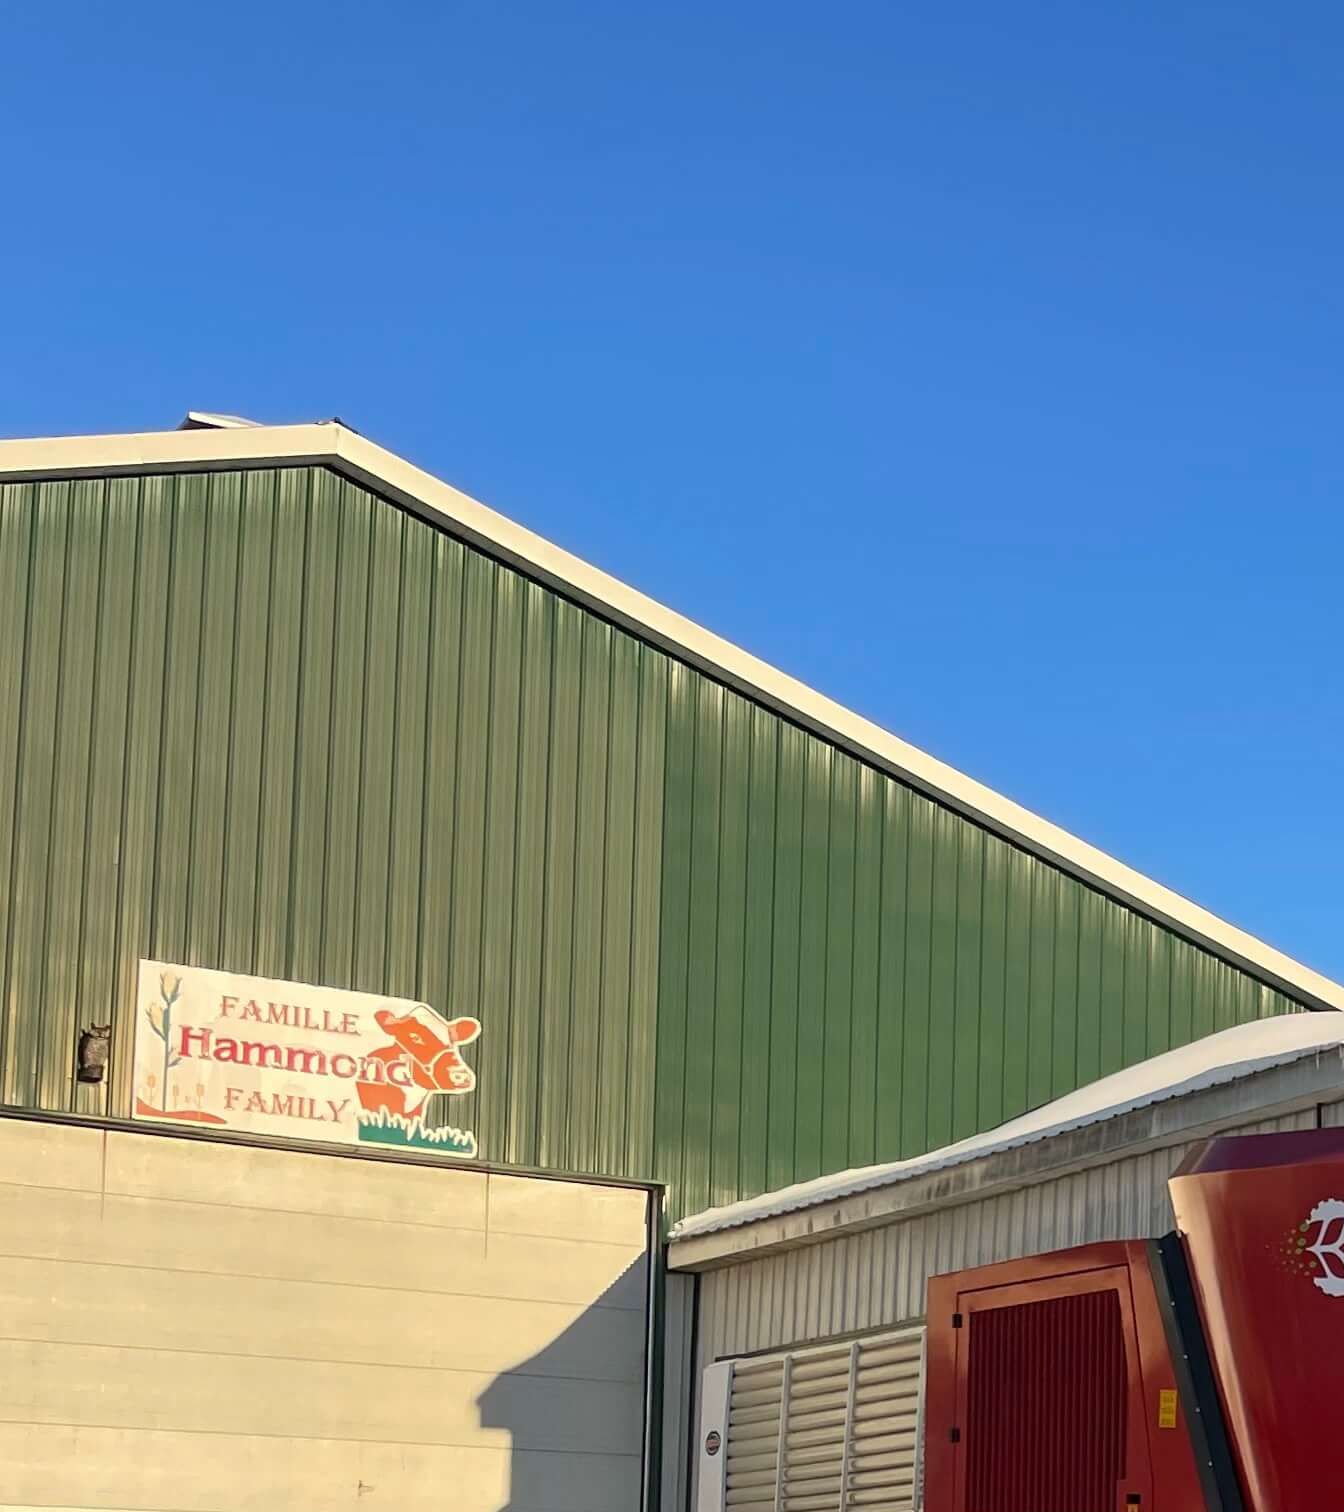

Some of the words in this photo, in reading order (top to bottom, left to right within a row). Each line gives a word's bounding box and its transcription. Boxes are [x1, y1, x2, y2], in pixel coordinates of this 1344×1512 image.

[219, 995, 361, 1036] FAMILLE
[178, 1024, 413, 1088] Hammond
[223, 1086, 350, 1123] FAMILY
